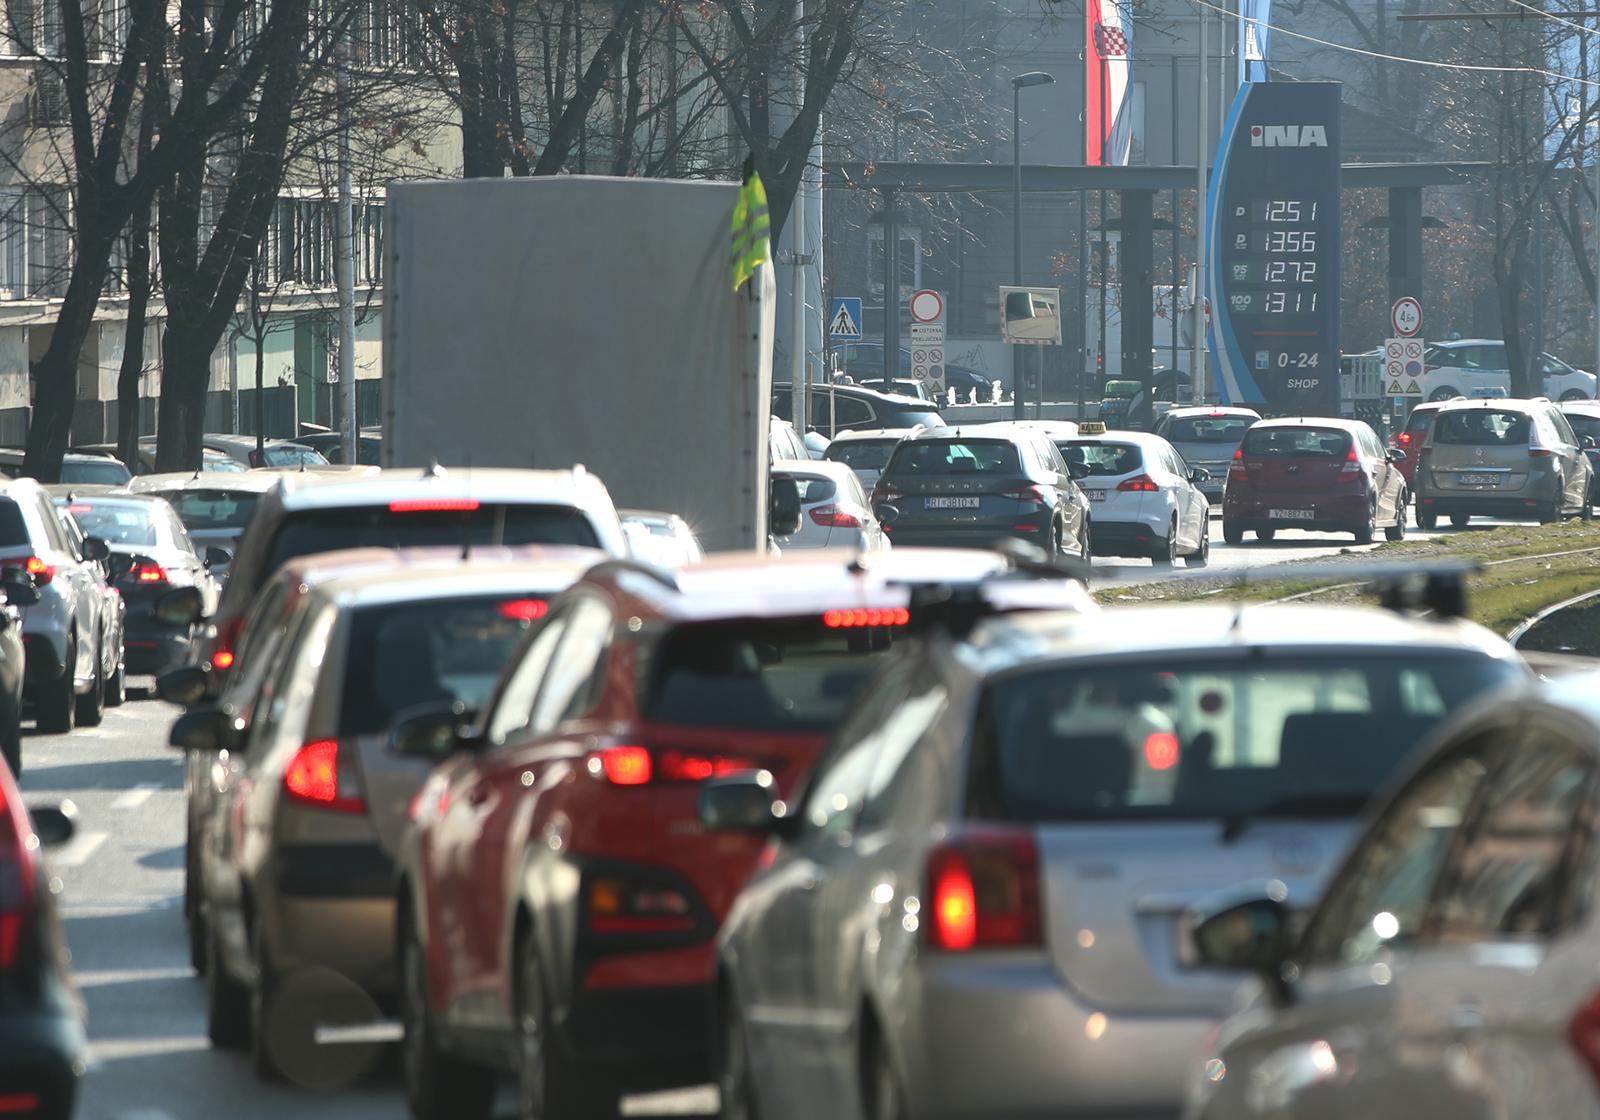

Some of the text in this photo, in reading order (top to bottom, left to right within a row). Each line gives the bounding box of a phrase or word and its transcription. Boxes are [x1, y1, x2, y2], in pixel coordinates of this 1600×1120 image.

[1236, 207, 1246, 216] D
[1233, 265, 1248, 274] 95
[1231, 295, 1252, 305] 100
[1278, 352, 1319, 368] 0-24
[1287, 378, 1319, 389] SHOP
